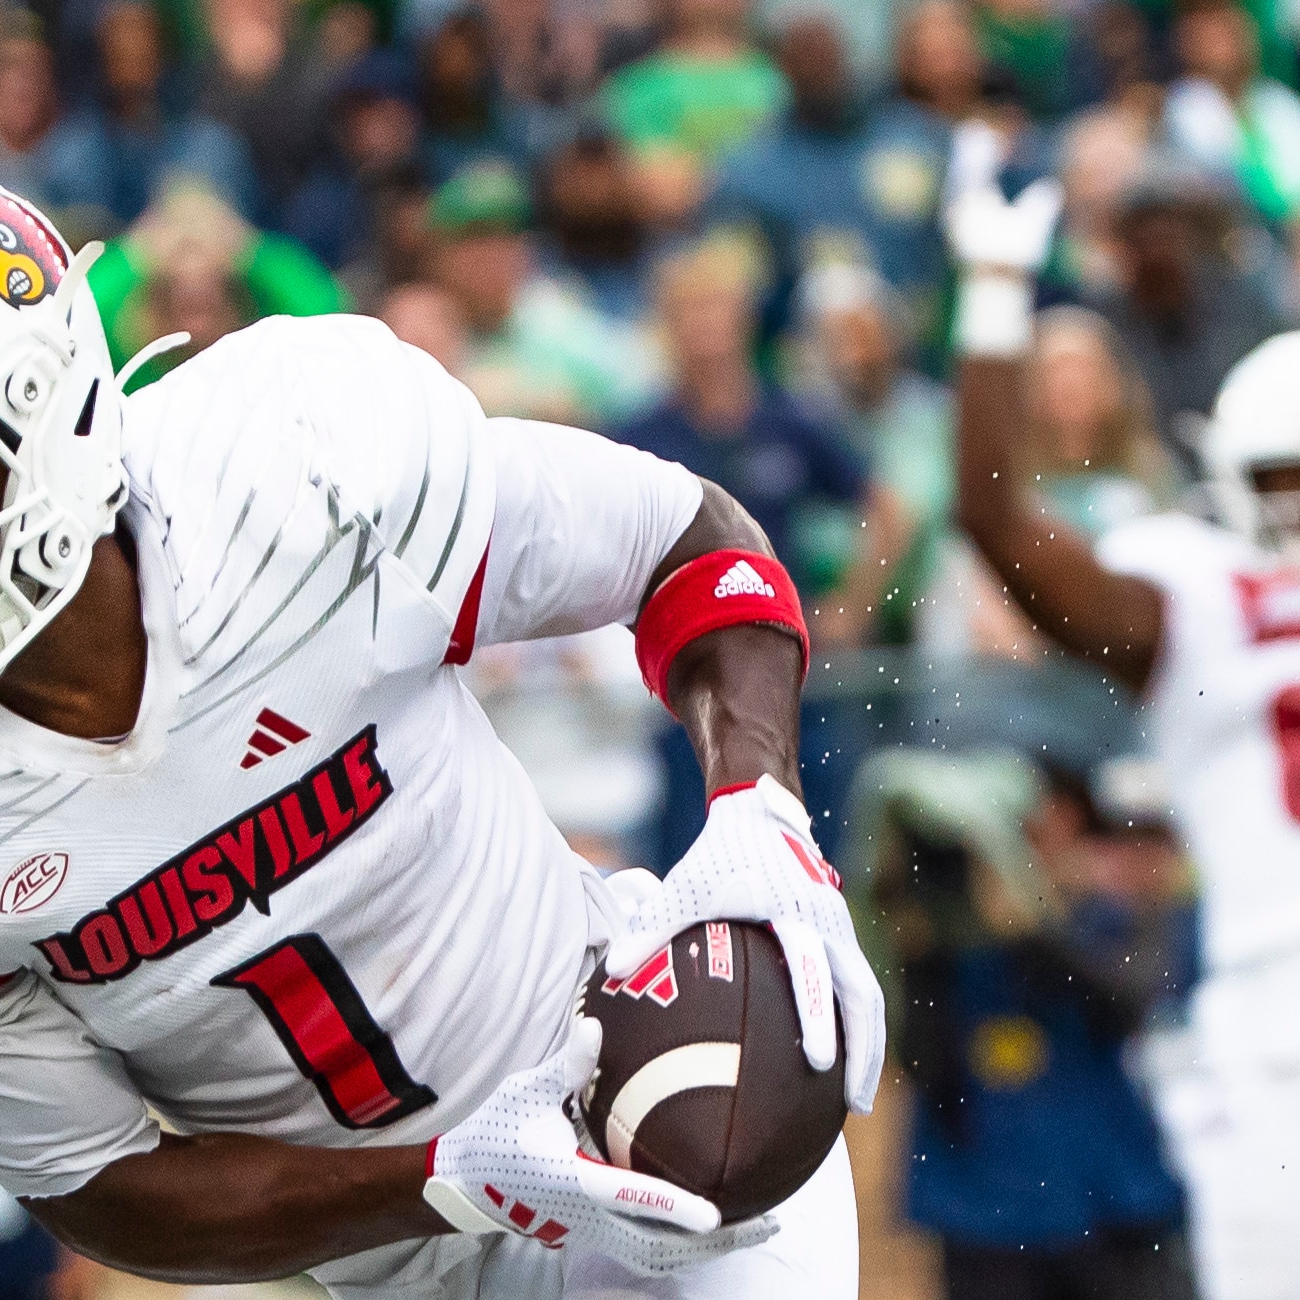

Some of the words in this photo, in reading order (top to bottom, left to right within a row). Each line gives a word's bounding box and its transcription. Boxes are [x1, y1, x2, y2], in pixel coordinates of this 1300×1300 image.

[714, 582, 776, 598] adidas
[12, 854, 57, 906] ACC
[32, 724, 394, 985] LOUISVILLE
[210, 933, 438, 1129] 1
[615, 1187, 675, 1212] ADIZERO
